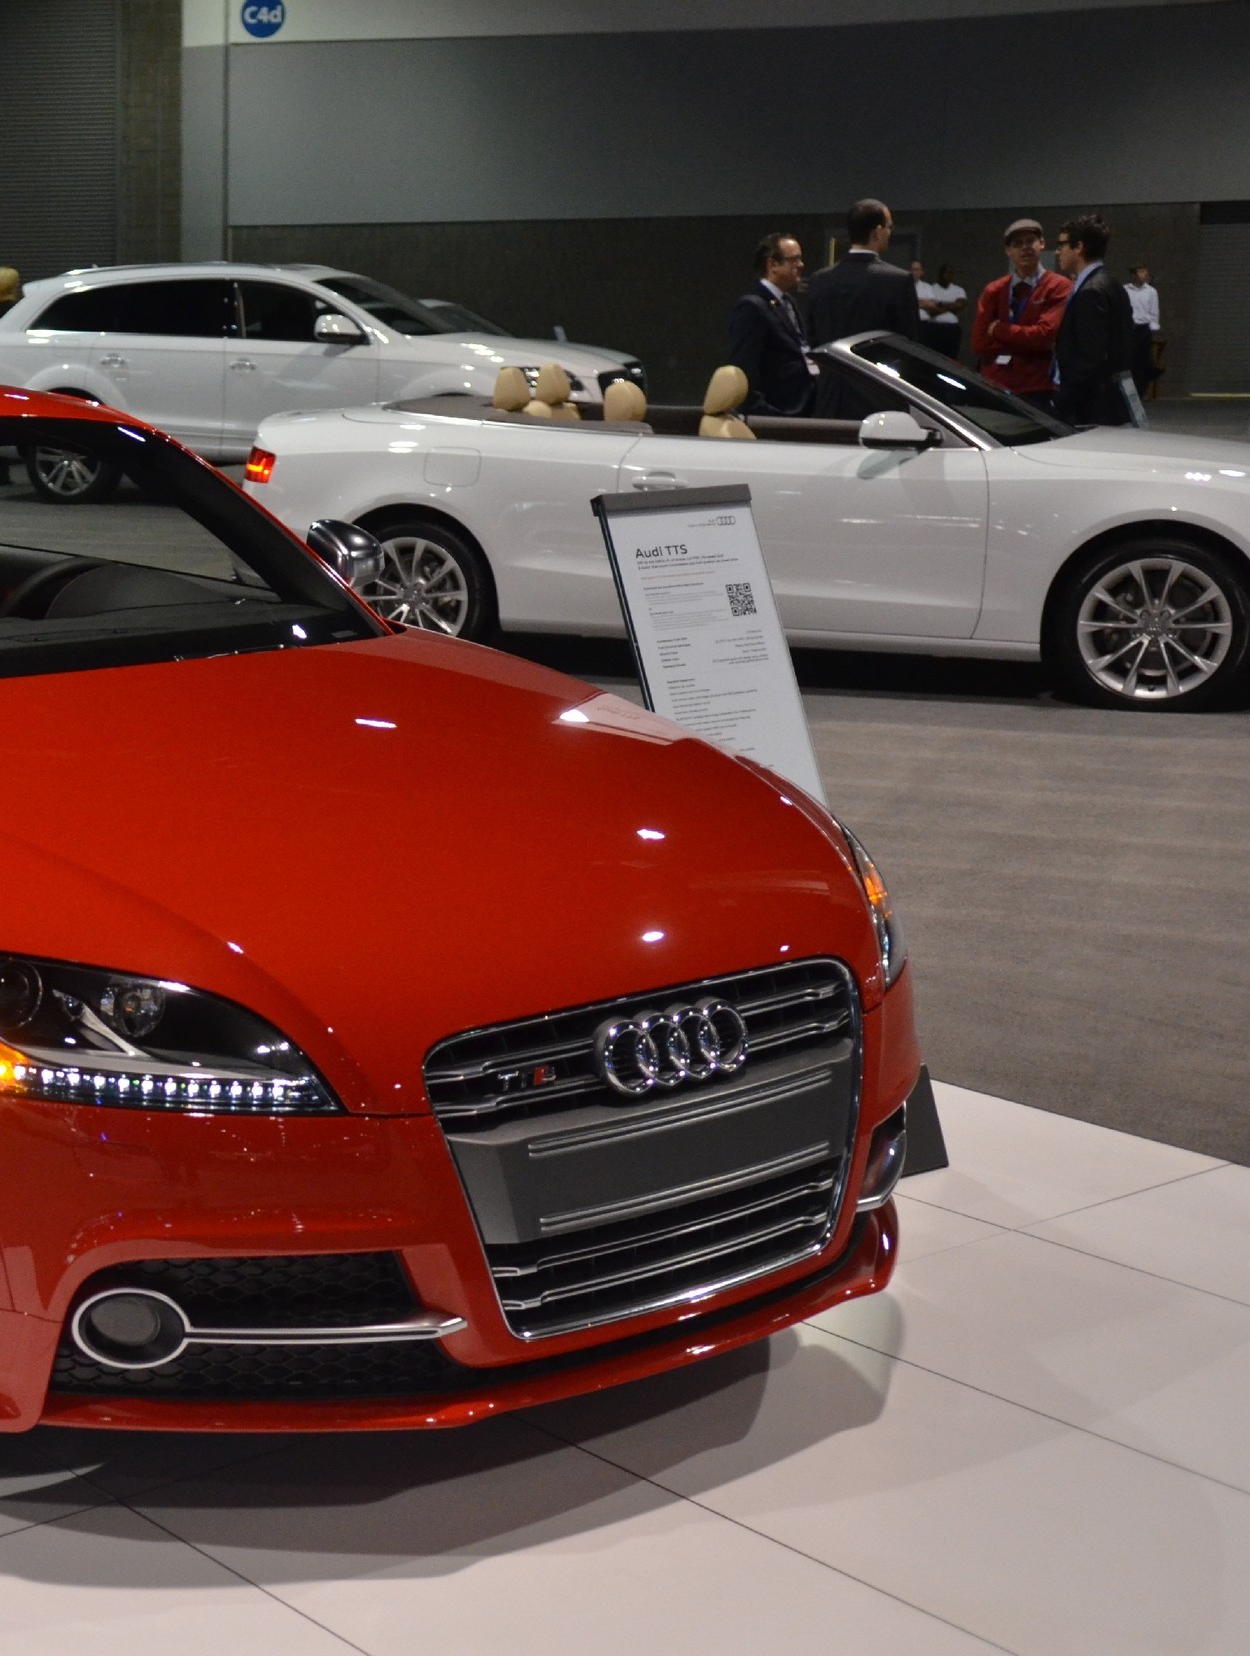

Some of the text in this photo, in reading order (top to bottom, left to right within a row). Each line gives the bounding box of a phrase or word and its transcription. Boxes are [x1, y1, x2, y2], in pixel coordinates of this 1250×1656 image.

[243, 5, 282, 24] C4d
[635, 544, 688, 559] Audi TTS
